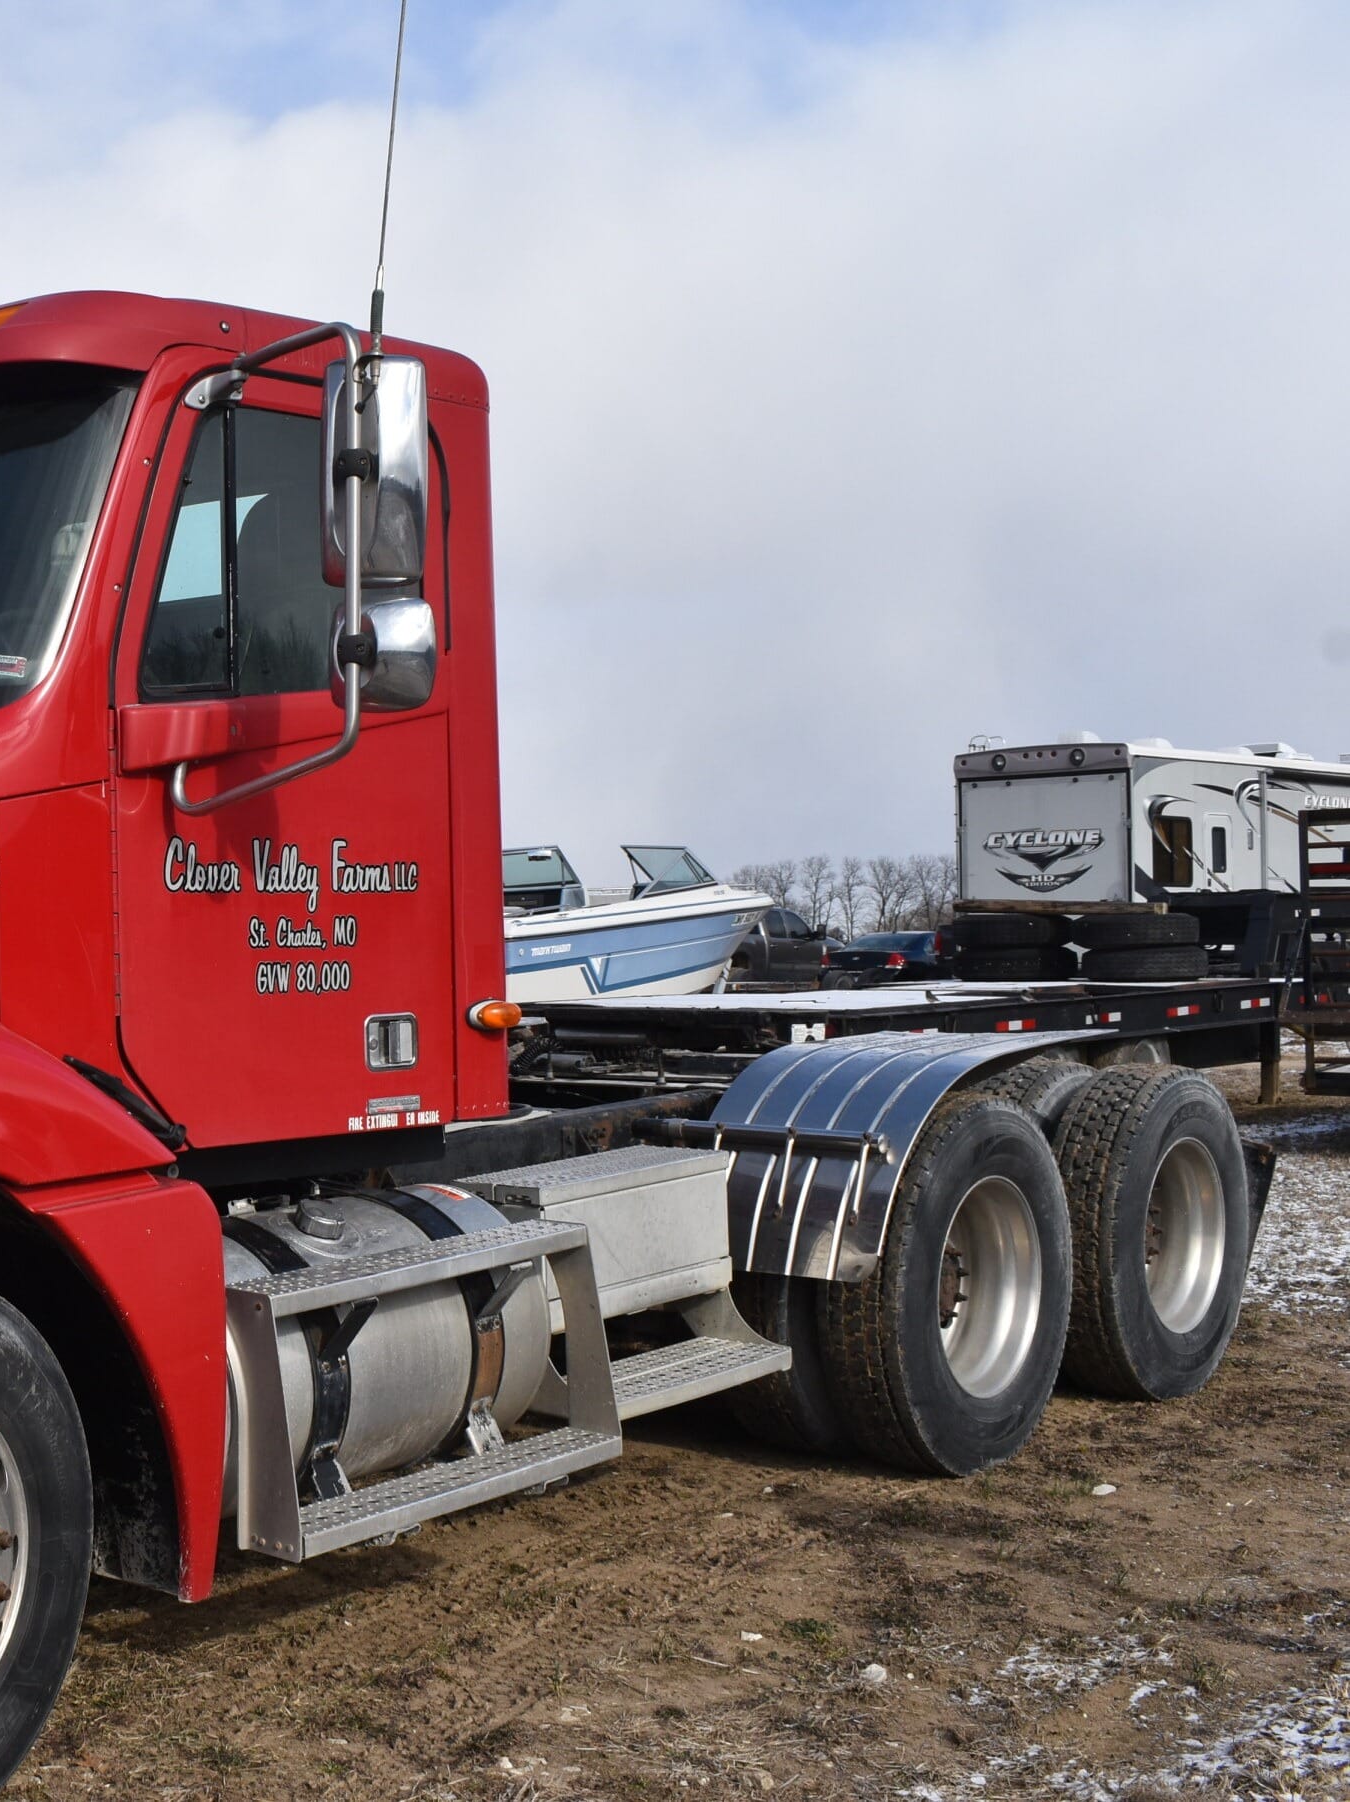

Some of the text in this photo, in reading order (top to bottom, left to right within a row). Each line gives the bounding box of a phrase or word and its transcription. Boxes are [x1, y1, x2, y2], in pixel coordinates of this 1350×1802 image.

[1304, 794, 1350, 809] CYCLON
[987, 828, 1100, 848] CYCLONE
[163, 836, 418, 913] Clover Valley Farms LLC
[249, 915, 357, 950] St. Charles, MO
[256, 962, 351, 994] GVW 80,000
[348, 1116, 364, 1131] FIRE
[417, 1110, 440, 1125] INSIDE
